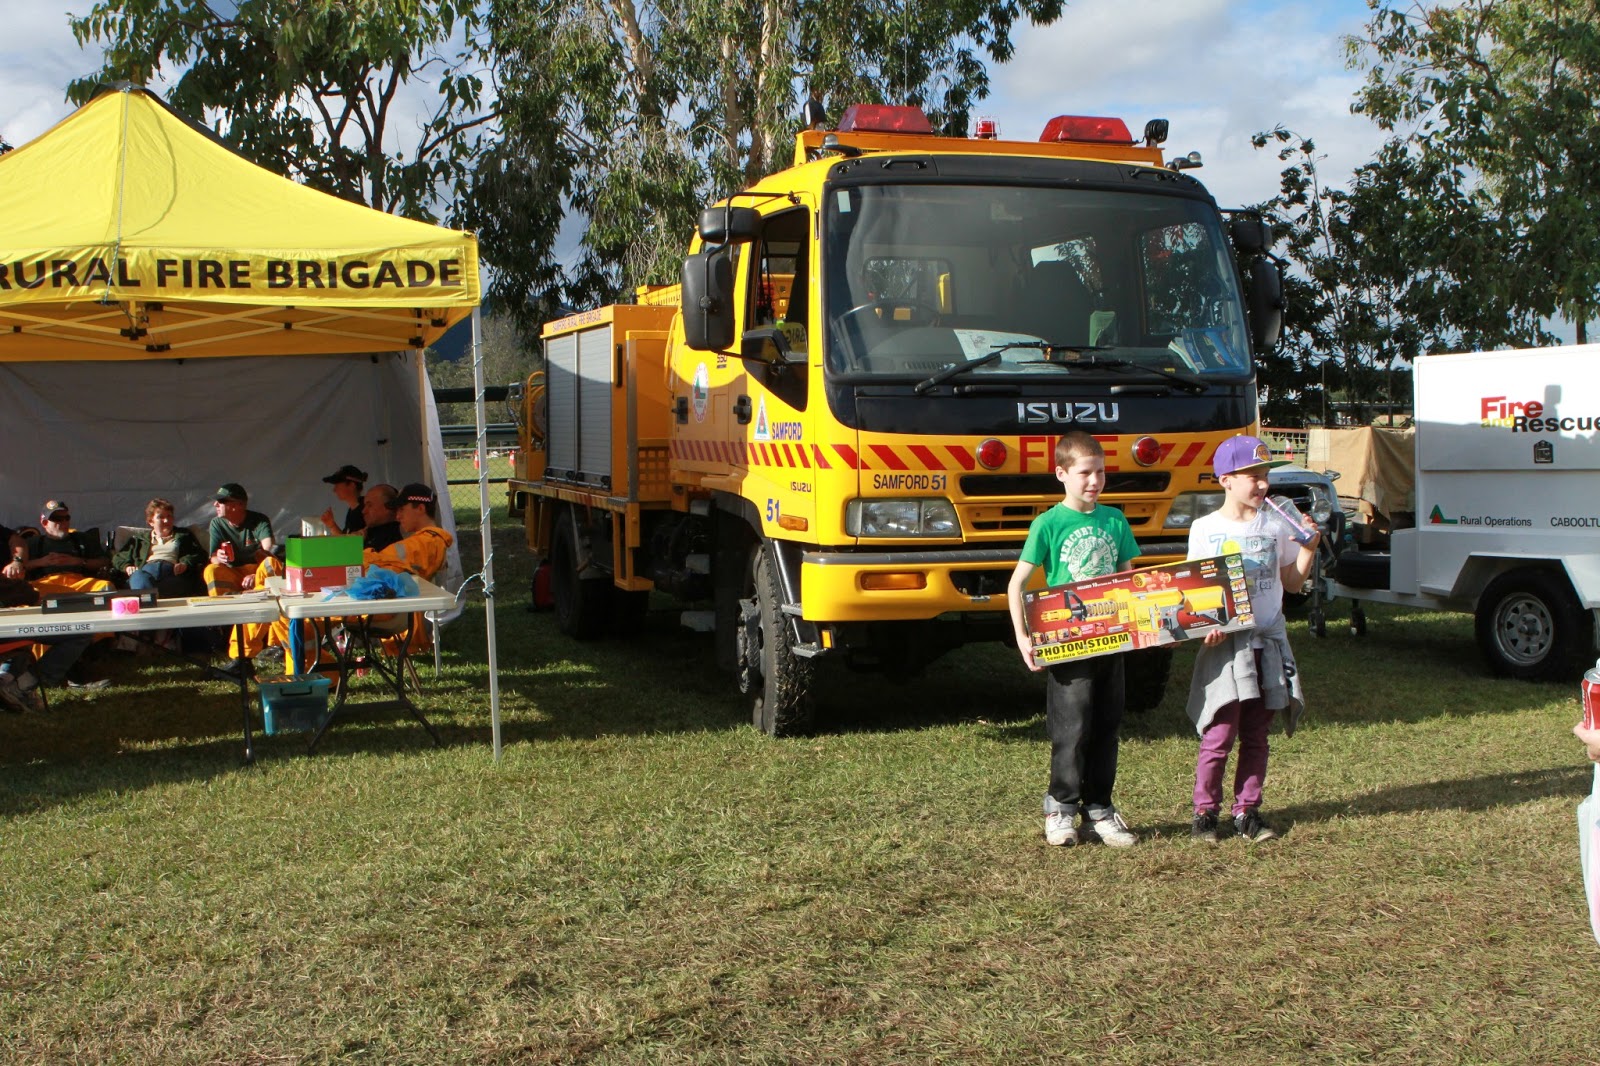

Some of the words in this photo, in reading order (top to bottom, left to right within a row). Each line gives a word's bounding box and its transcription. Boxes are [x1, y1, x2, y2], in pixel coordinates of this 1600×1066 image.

[156, 259, 251, 288] FIRE
[267, 259, 462, 288] BRIGADE
[1017, 402, 1120, 424] ISUZU
[1481, 396, 1544, 420] Fire
[1481, 414, 1515, 428] and
[772, 422, 802, 441] SAMFORD
[1019, 436, 1120, 473] FIE
[790, 481, 811, 493] ISUZU
[873, 474, 929, 490] SAMFORD
[931, 475, 947, 490] 51
[766, 498, 780, 523] 51
[1460, 515, 1482, 526] Rural
[1484, 516, 1532, 528] Operations
[38, 625, 72, 633] OUTSIDE
[1036, 641, 1084, 657] PHOTON
[1087, 633, 1129, 648] STORM
[1046, 653, 1076, 661] Semi-Auto
